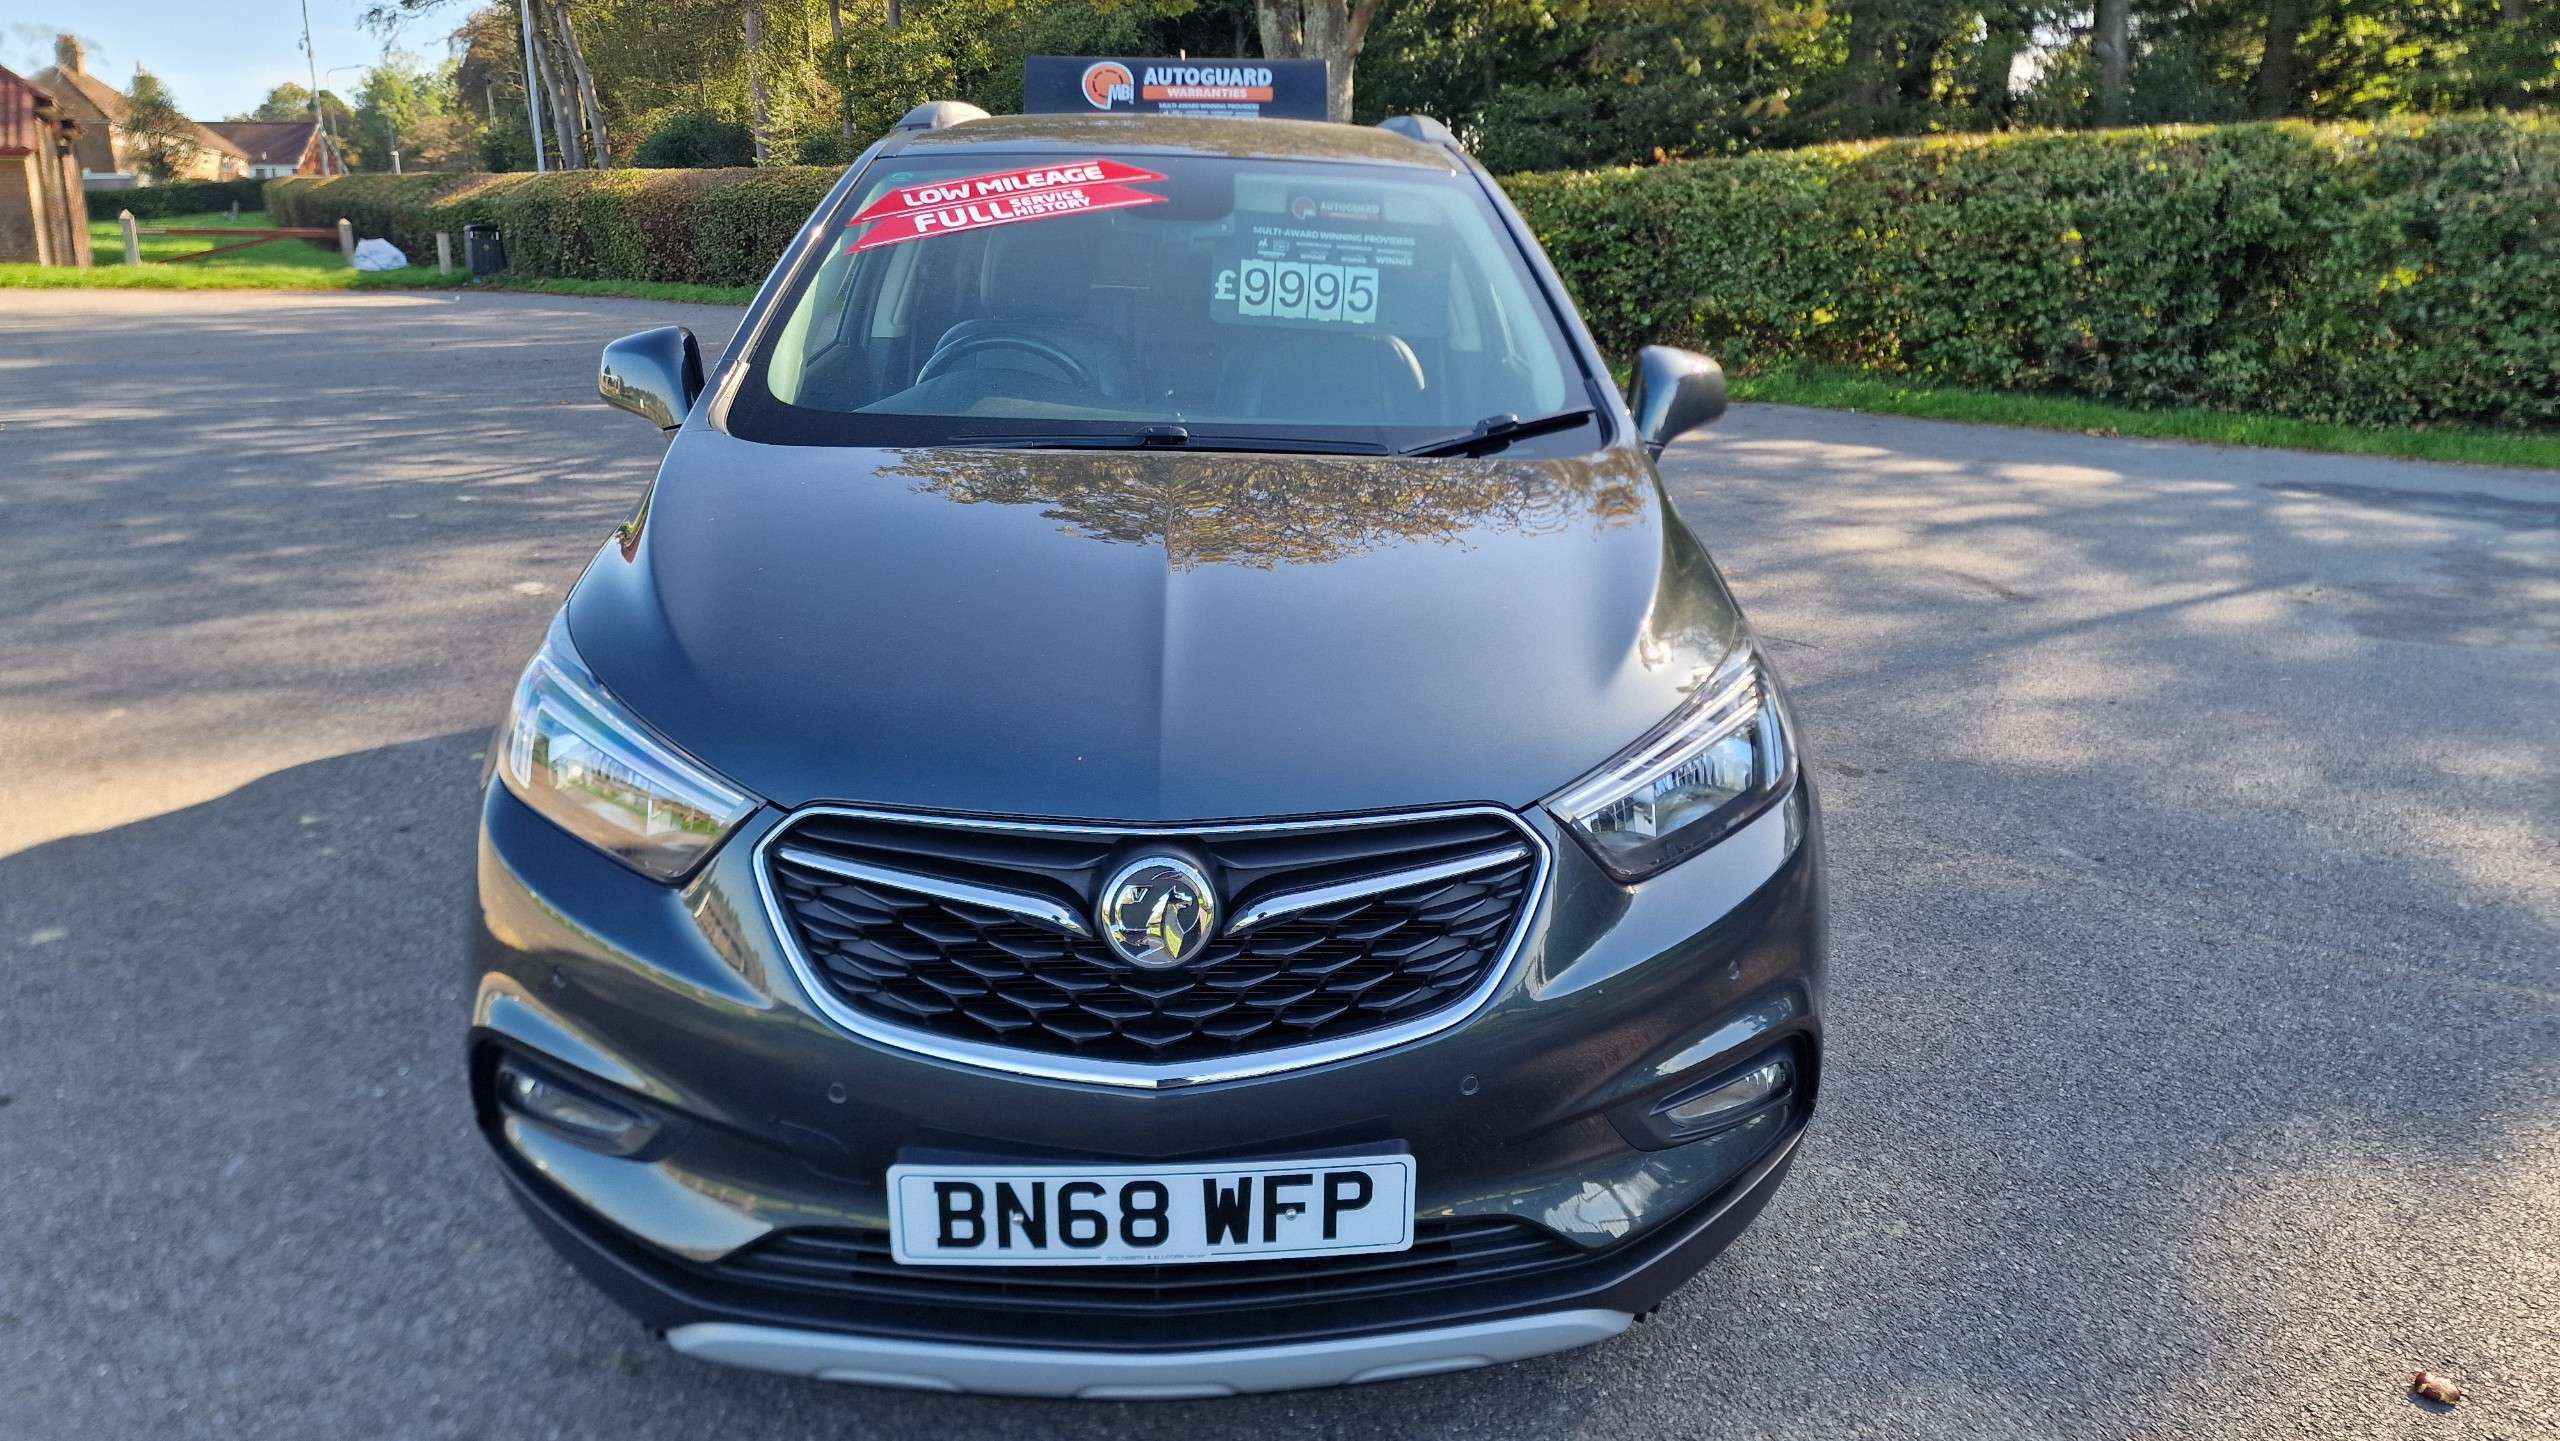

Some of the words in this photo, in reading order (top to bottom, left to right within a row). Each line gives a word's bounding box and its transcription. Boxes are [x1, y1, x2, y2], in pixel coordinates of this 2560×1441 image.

[1143, 67, 1273, 87] AUTOGUARD
[1167, 87, 1248, 99] WARRANTIES
[903, 184, 970, 206] LOW
[978, 165, 1104, 195] MILEAGE
[1009, 189, 1084, 208] SERVICE
[1011, 198, 1092, 217] HISTORY
[1319, 201, 1381, 214] AUTOGUARD
[914, 202, 1014, 232] FULL
[1319, 231, 1363, 243] WINNING
[1364, 234, 1416, 247] PROVIDERS
[933, 1180, 1170, 1250] BN68
[1202, 1170, 1374, 1247] WFP
